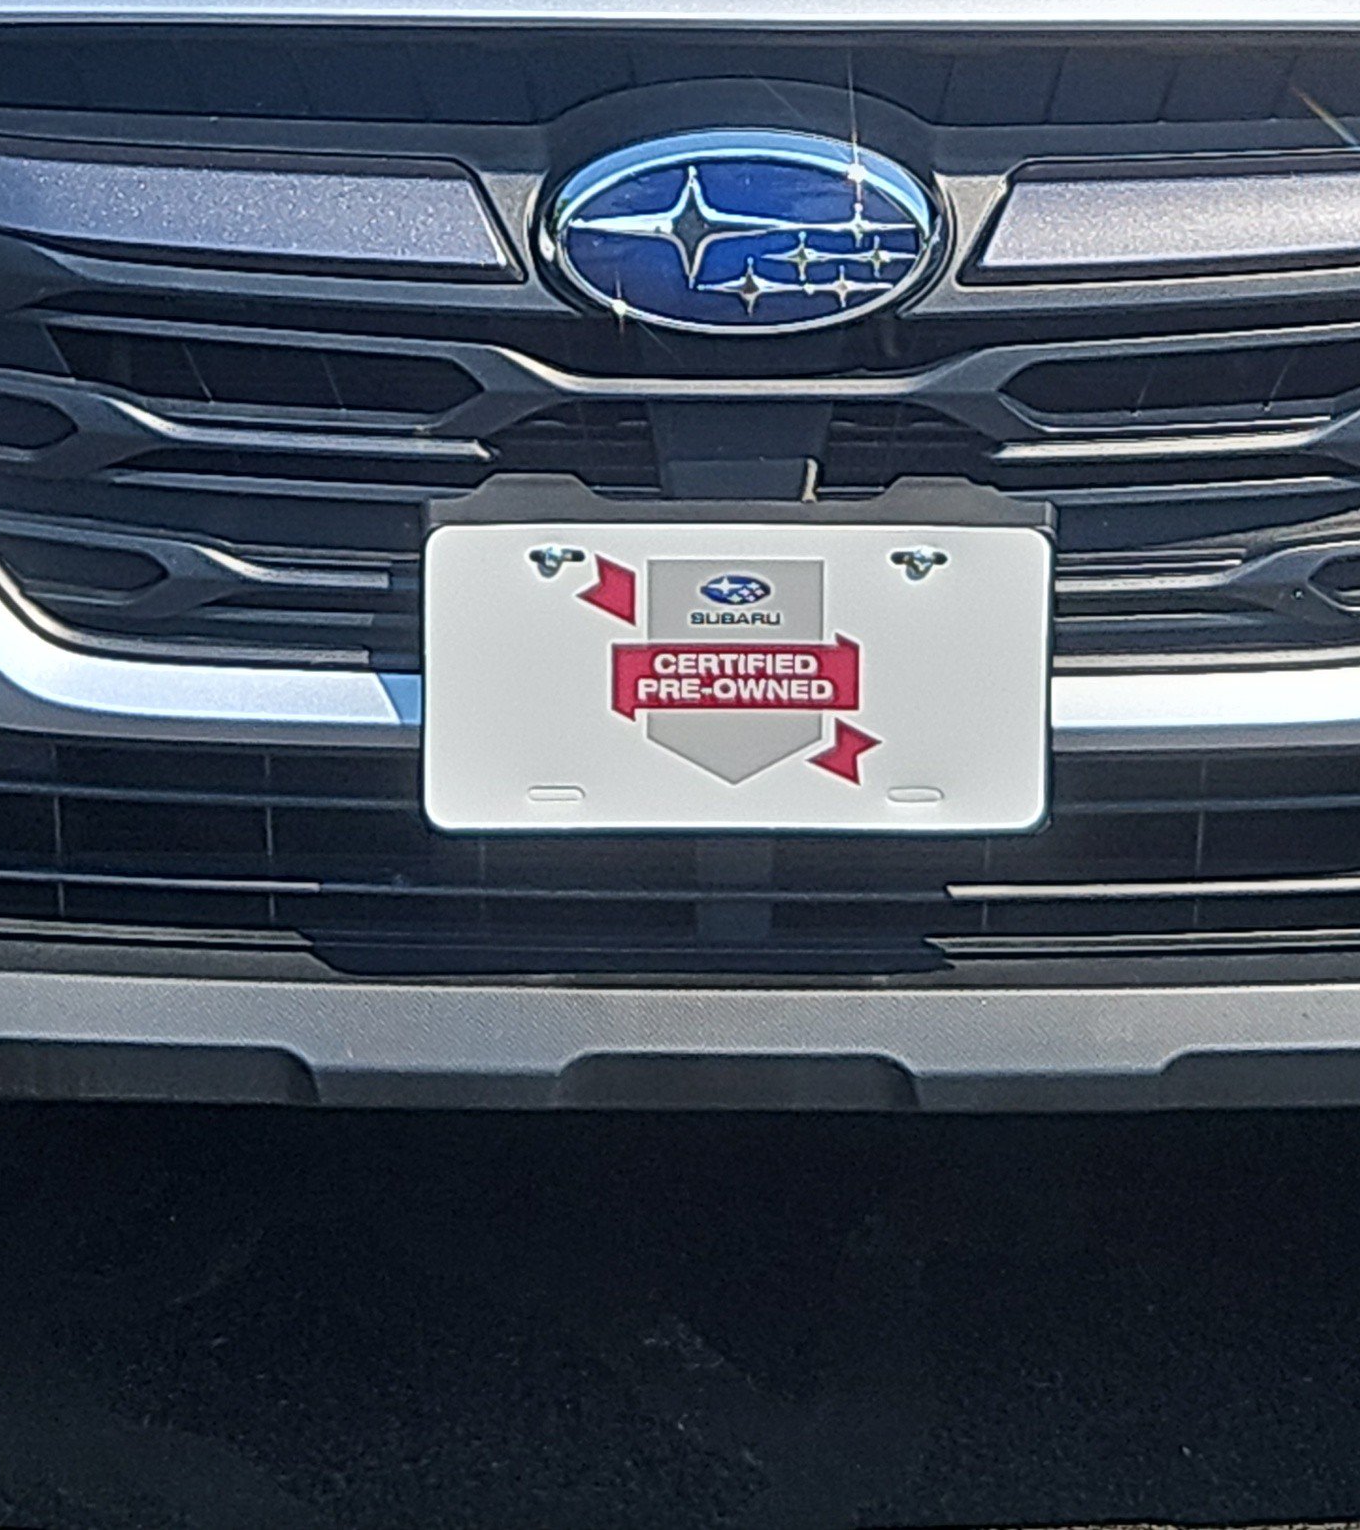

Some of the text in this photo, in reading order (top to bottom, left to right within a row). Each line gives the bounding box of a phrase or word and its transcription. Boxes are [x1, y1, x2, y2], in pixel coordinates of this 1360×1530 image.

[690, 612, 781, 626] SUBARU
[653, 653, 819, 676] CERTIFIED
[637, 677, 834, 701] PRE-OWNED
